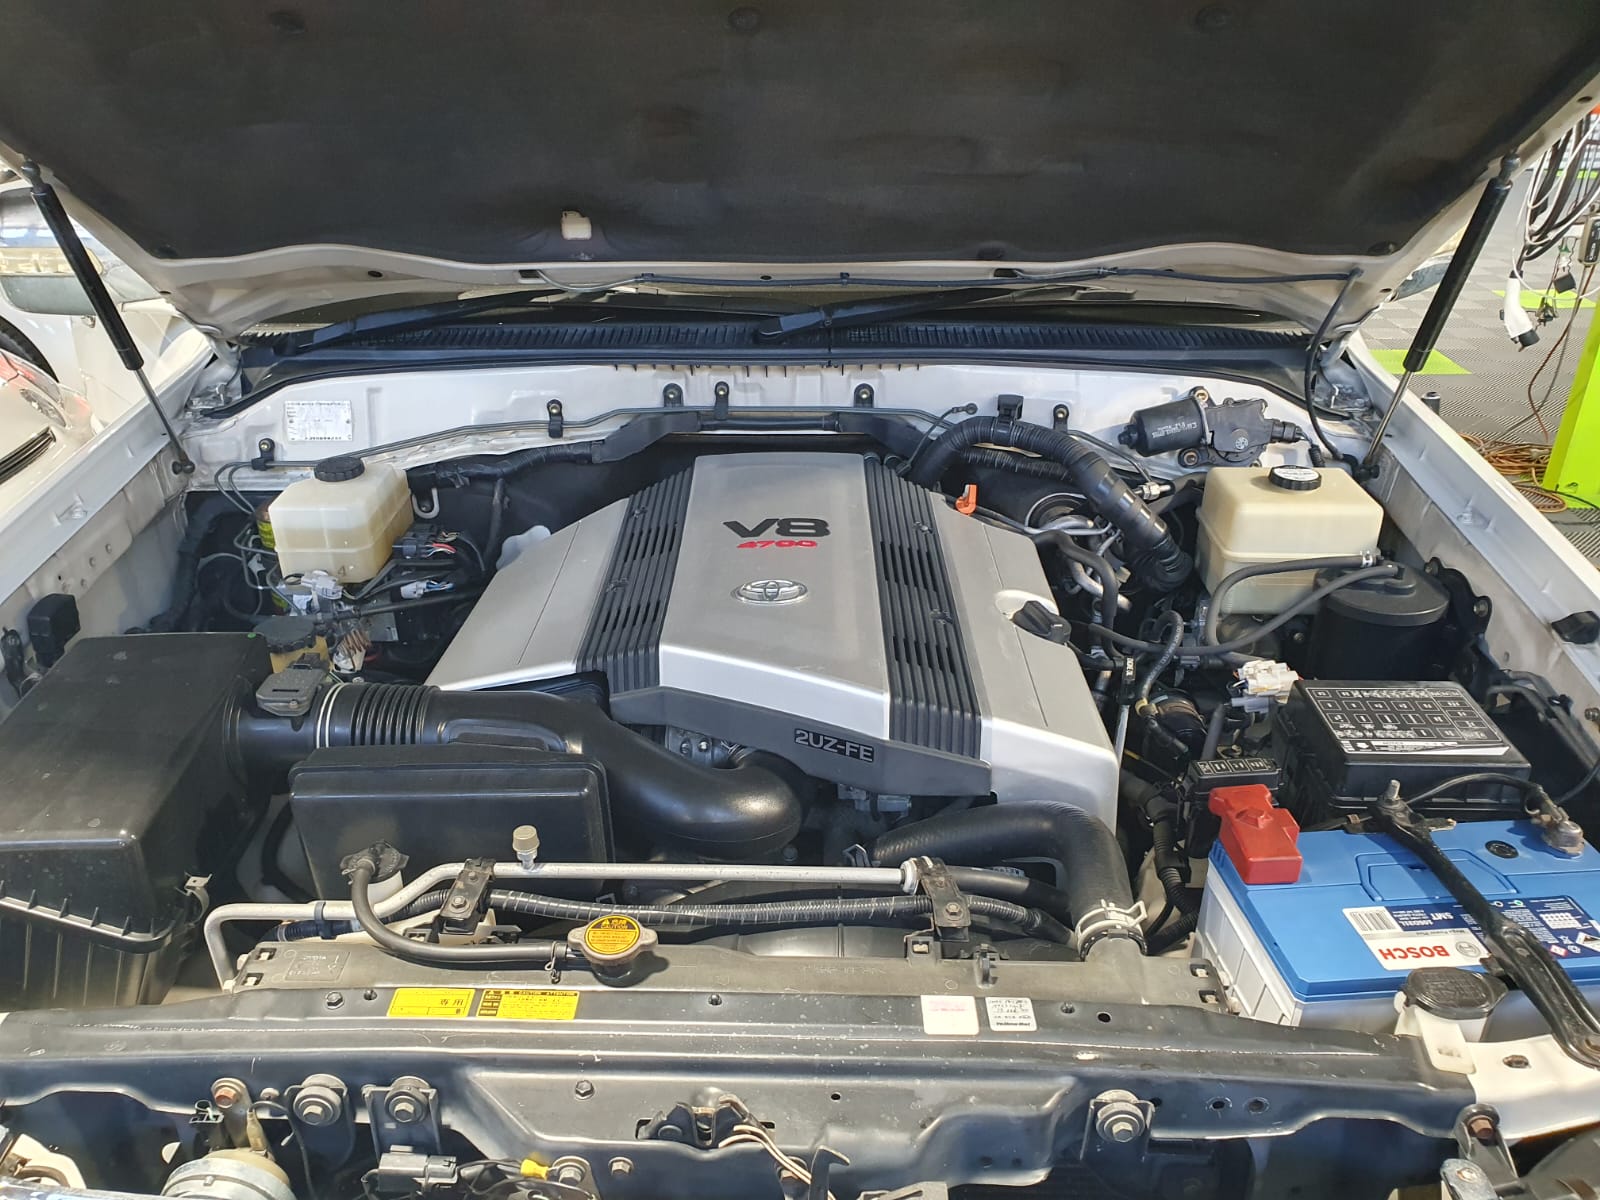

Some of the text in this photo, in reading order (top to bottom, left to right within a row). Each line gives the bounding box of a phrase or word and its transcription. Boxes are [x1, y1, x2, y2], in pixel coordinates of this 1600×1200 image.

[722, 517, 831, 538] V8
[736, 540, 818, 549] 4700
[795, 729, 873, 762] 2UZ-FE
[1378, 945, 1450, 960] BOSCH
